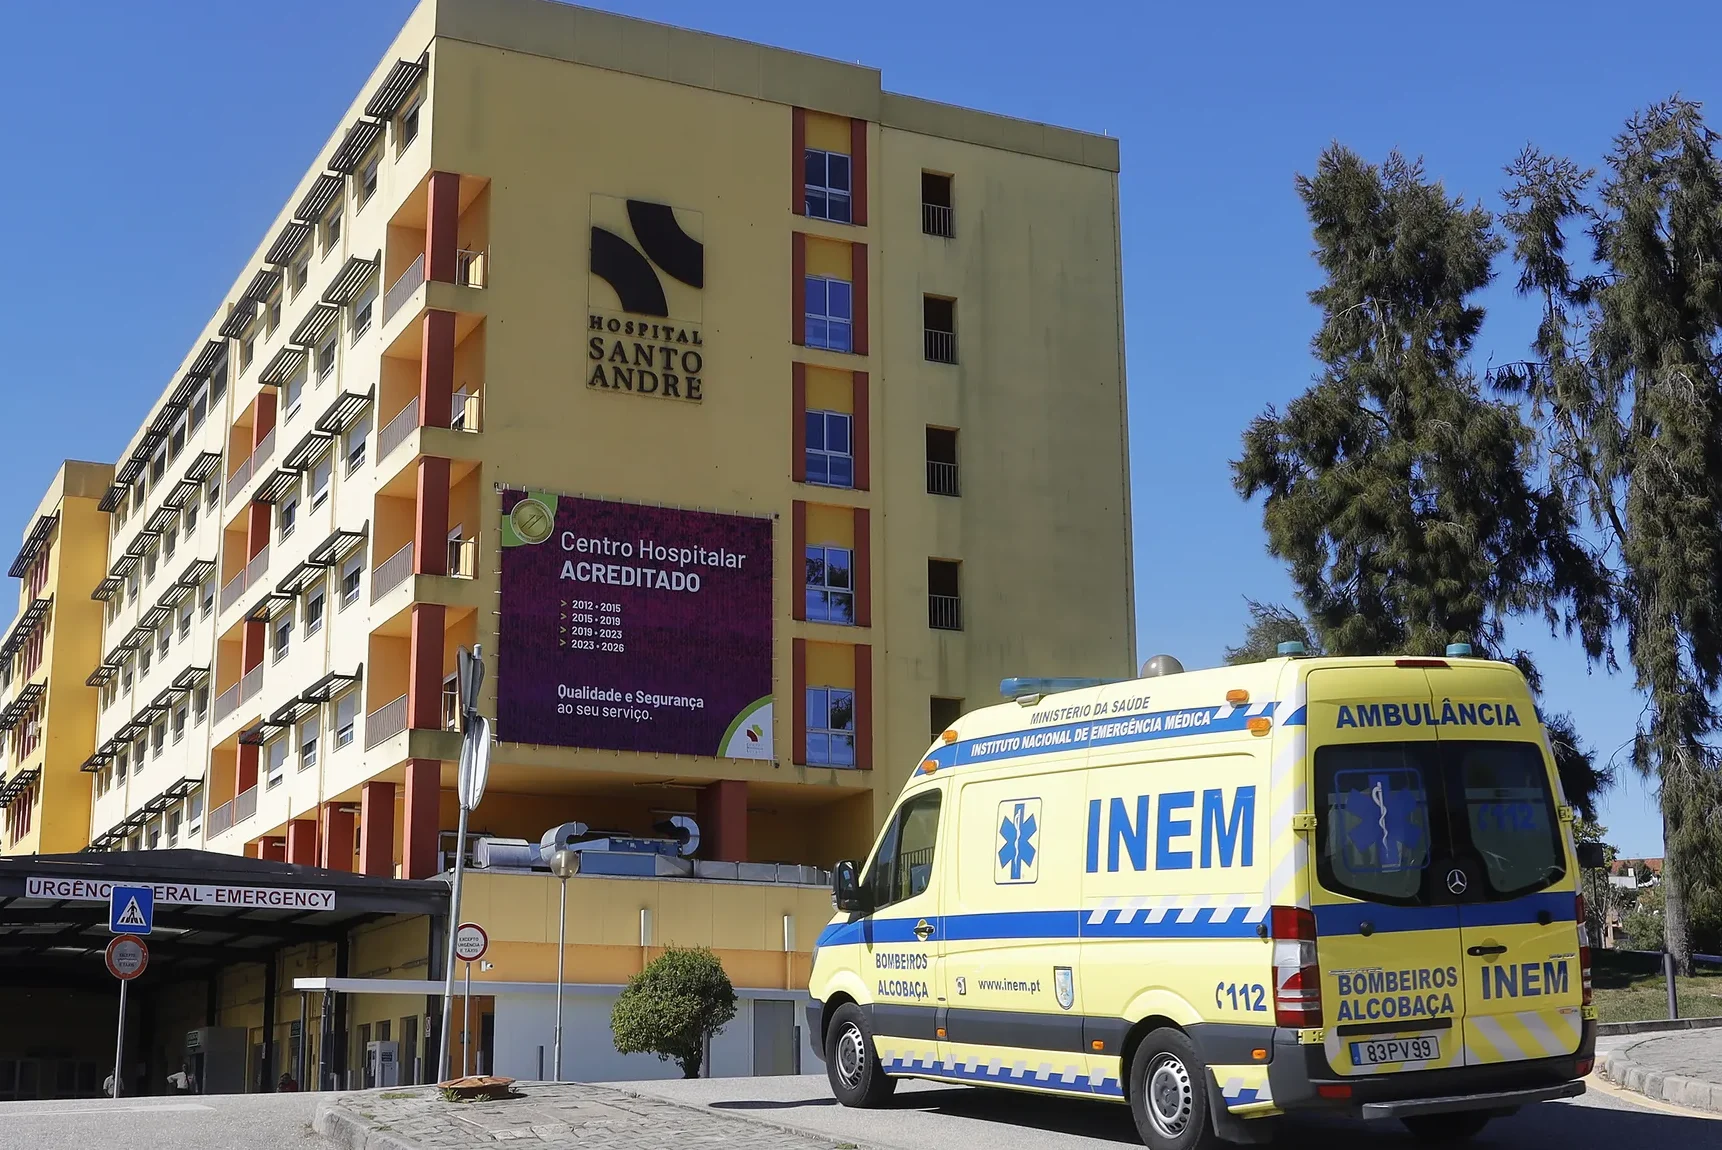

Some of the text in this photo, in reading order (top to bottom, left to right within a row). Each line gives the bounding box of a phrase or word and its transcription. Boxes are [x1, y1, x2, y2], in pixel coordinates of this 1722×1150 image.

[589, 315, 703, 345] HOSPITAL
[589, 337, 703, 374] SANTO
[561, 531, 746, 568] Centro Hospitalar
[559, 560, 701, 593] ACREDITADO
[572, 600, 621, 613] 2012 2015
[572, 613, 621, 626] 2015 2019
[571, 626, 623, 639] 2019 2023
[571, 639, 625, 653] 2023 2026
[557, 684, 704, 711] Qualidade e Segurança
[1030, 695, 1150, 725] MINISTÉRIO DA SAÚDE
[557, 703, 653, 722] ao seu serviço.
[1336, 698, 1521, 729] AMBULÂNCIA
[971, 710, 1210, 757] INSTITUTO NACIONAL DE EMERGÊNCIA MÉDICA
[1086, 785, 1256, 873] INEM
[29, 880, 130, 898] URGÊNC
[142, 885, 203, 902] ERAL
[876, 953, 928, 970] BOMBEIROS
[878, 980, 929, 1001] ALCOBAÇA
[978, 978, 1041, 995] www.inem.pt
[1338, 966, 1458, 996] BOMBEIROS
[1481, 961, 1569, 1000] INEM
[1226, 983, 1267, 1012] 112
[1337, 993, 1455, 1021] ALCOBAÇA
[1367, 1040, 1431, 1062] 83PV99
